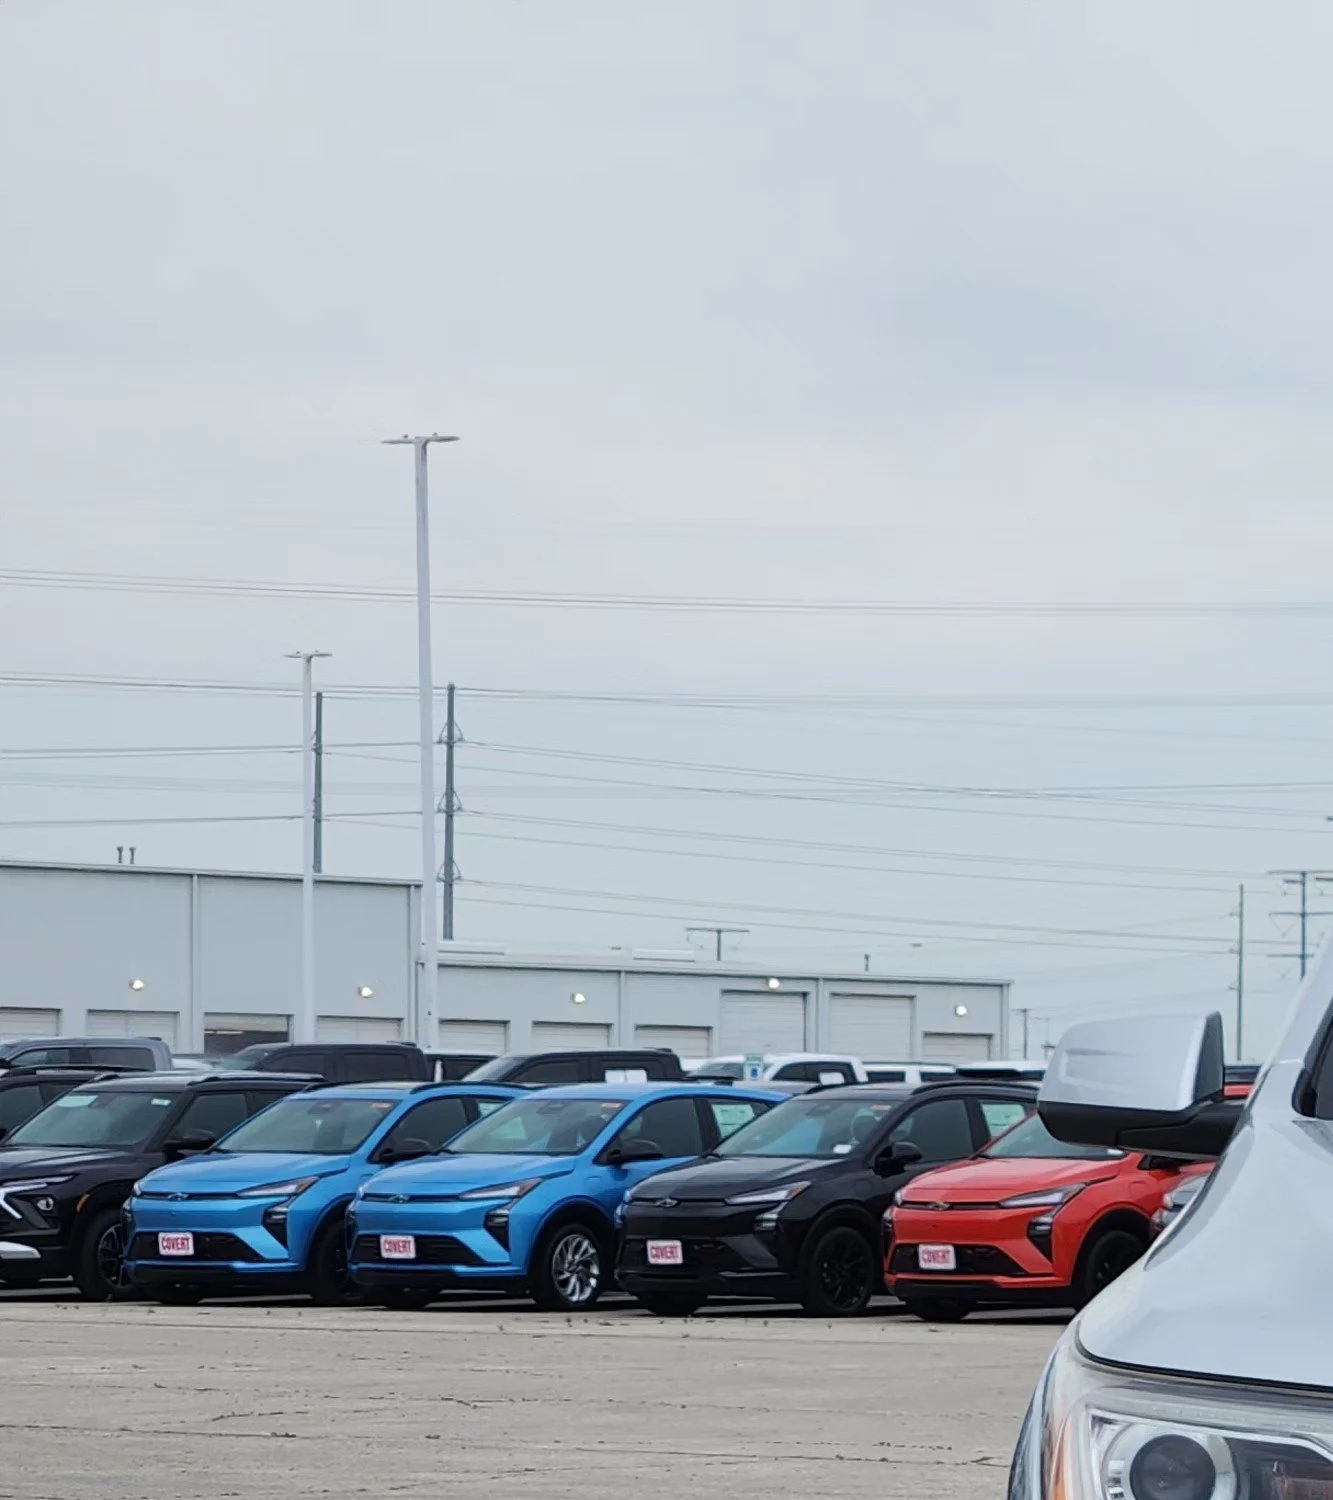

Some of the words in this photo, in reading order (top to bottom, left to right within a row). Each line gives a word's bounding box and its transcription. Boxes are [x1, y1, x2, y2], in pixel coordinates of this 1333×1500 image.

[162, 1237, 190, 1250] COVERT
[384, 1239, 411, 1253] COVERT
[651, 1245, 678, 1260] COVERT
